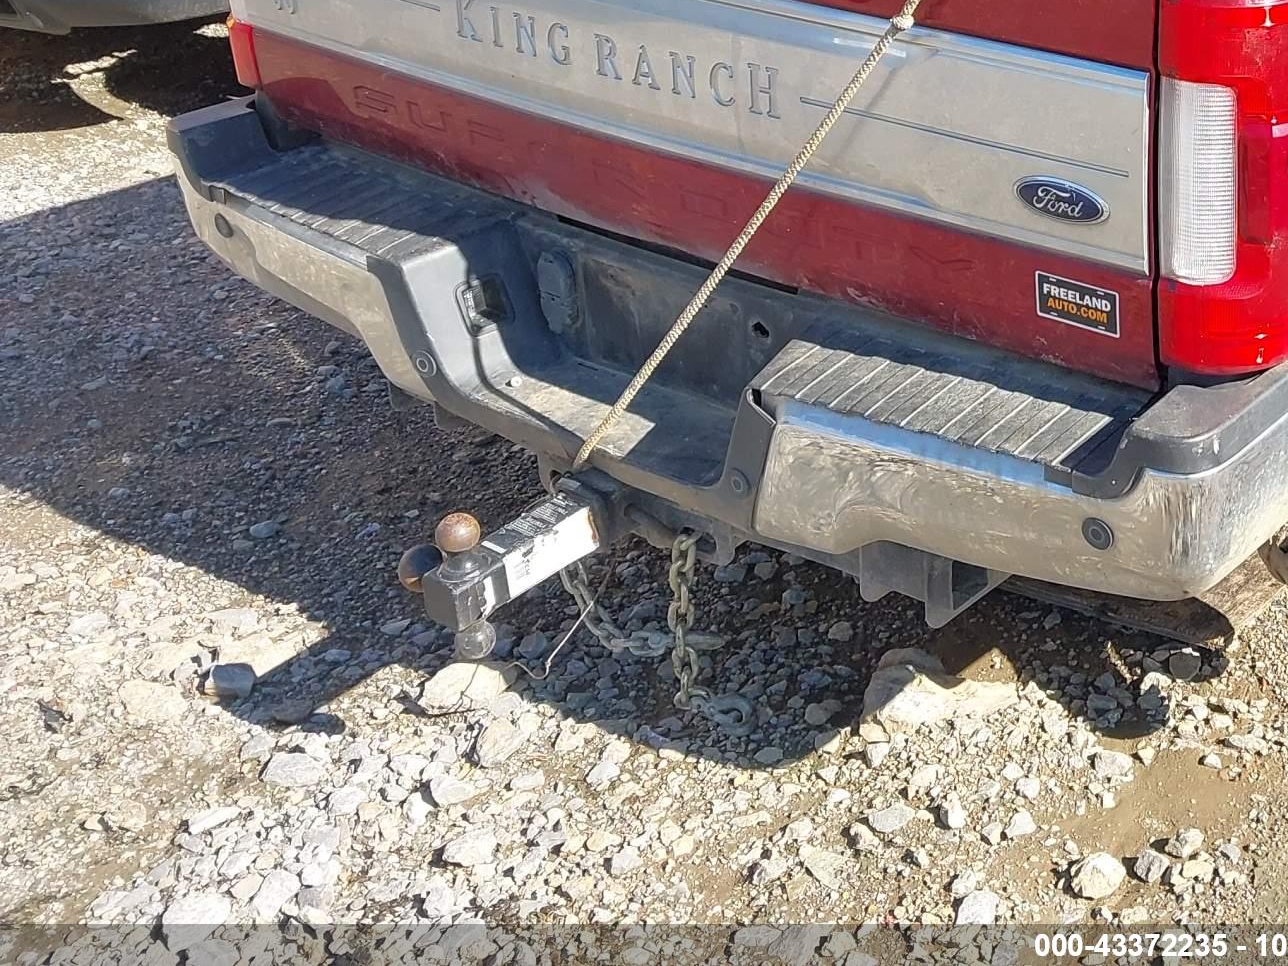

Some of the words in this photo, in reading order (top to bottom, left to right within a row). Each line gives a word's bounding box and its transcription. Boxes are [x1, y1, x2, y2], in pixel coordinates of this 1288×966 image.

[594, 32, 782, 120] RANCH
[1032, 185, 1085, 218] Ford
[1042, 283, 1112, 312] FREELAND
[1047, 297, 1108, 323] AUTO.COM
